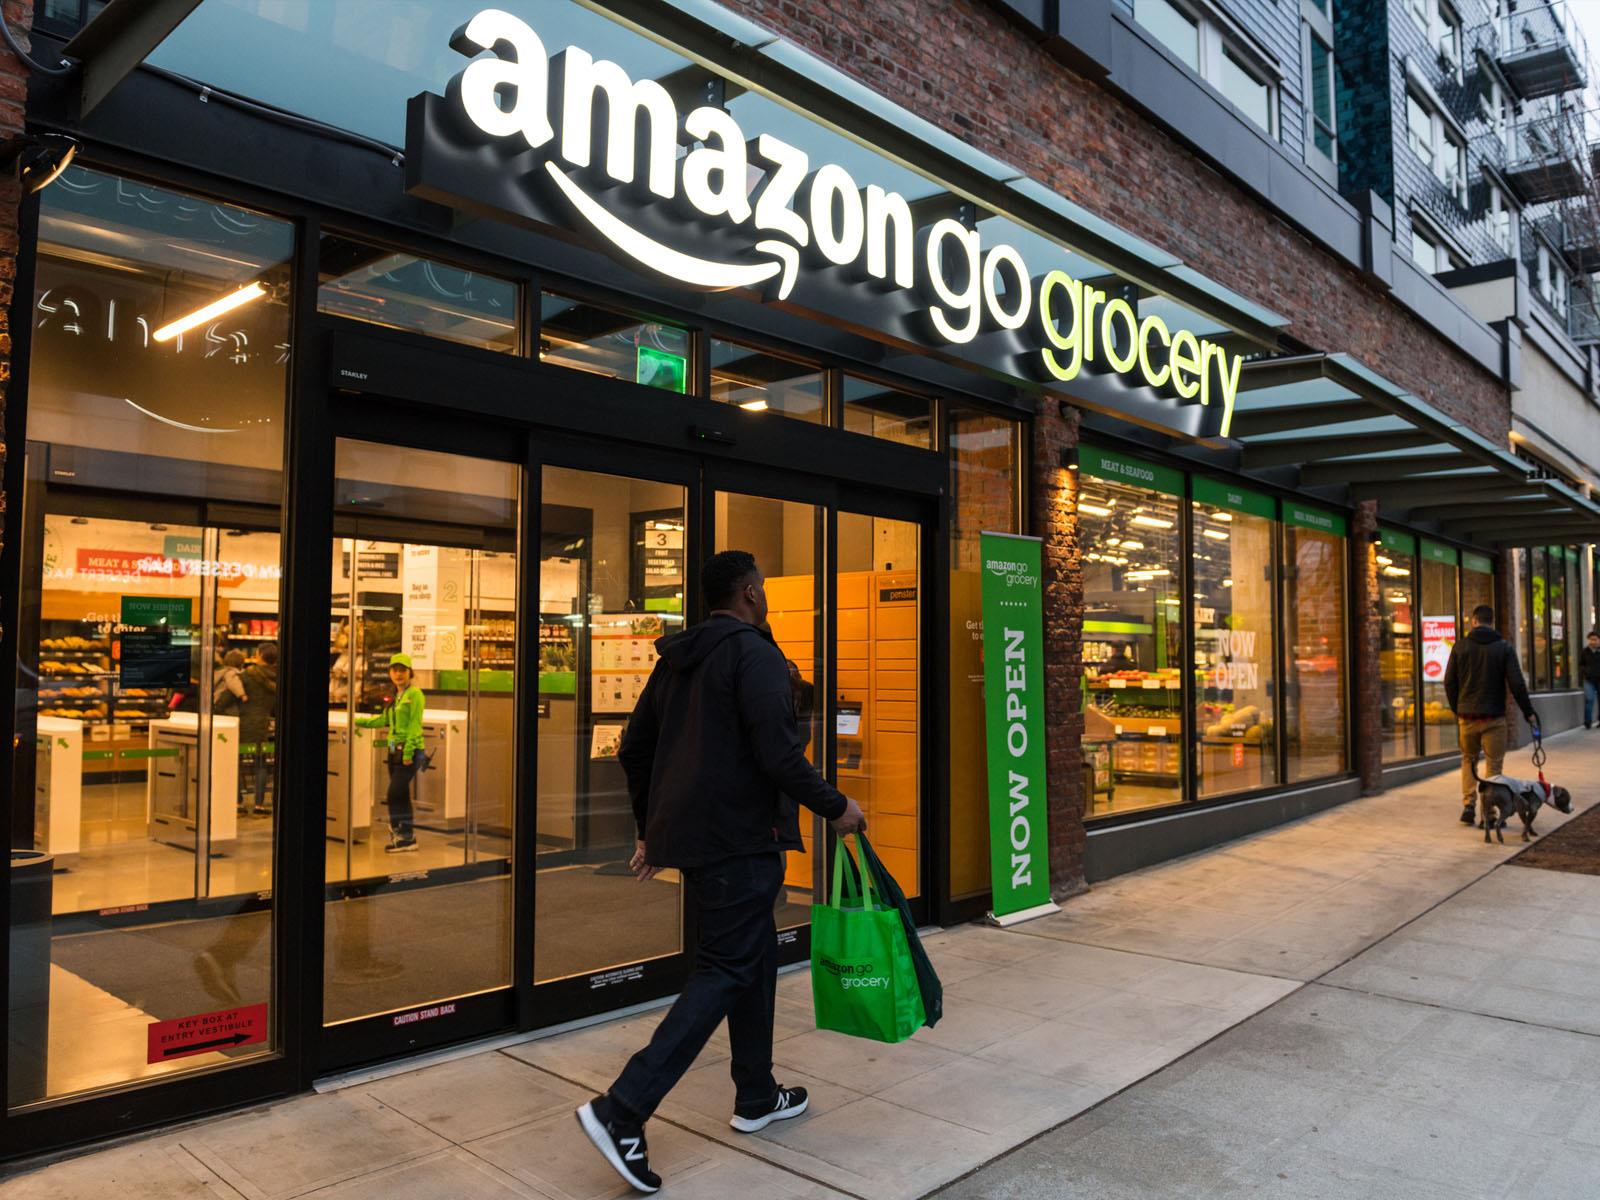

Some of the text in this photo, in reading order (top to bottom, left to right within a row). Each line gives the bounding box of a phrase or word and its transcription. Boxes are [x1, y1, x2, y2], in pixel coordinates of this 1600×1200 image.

[460, 8, 1242, 438] amazon go grocery
[340, 369, 368, 380] STANLEY
[1101, 458, 1119, 473] MEAT
[1125, 465, 1154, 481] SEAFOOD
[656, 533, 667, 546] 3
[176, 543, 202, 553] DAIR
[88, 557, 120, 569] MEAT
[986, 560, 1028, 575] amazon go
[1006, 574, 1038, 588] grocery
[966, 620, 978, 630] Get
[1217, 629, 1256, 657] NOW
[1215, 662, 1259, 690] OPEN
[1004, 627, 1032, 889] NOW OPEN
[855, 964, 873, 977] go
[841, 976, 890, 990] grocery
[177, 1012, 239, 1029] KEY BOX AT
[394, 1004, 456, 1026] CAUTION STAND BACK
[160, 1020, 253, 1043] ENTRY VESTIBULE
